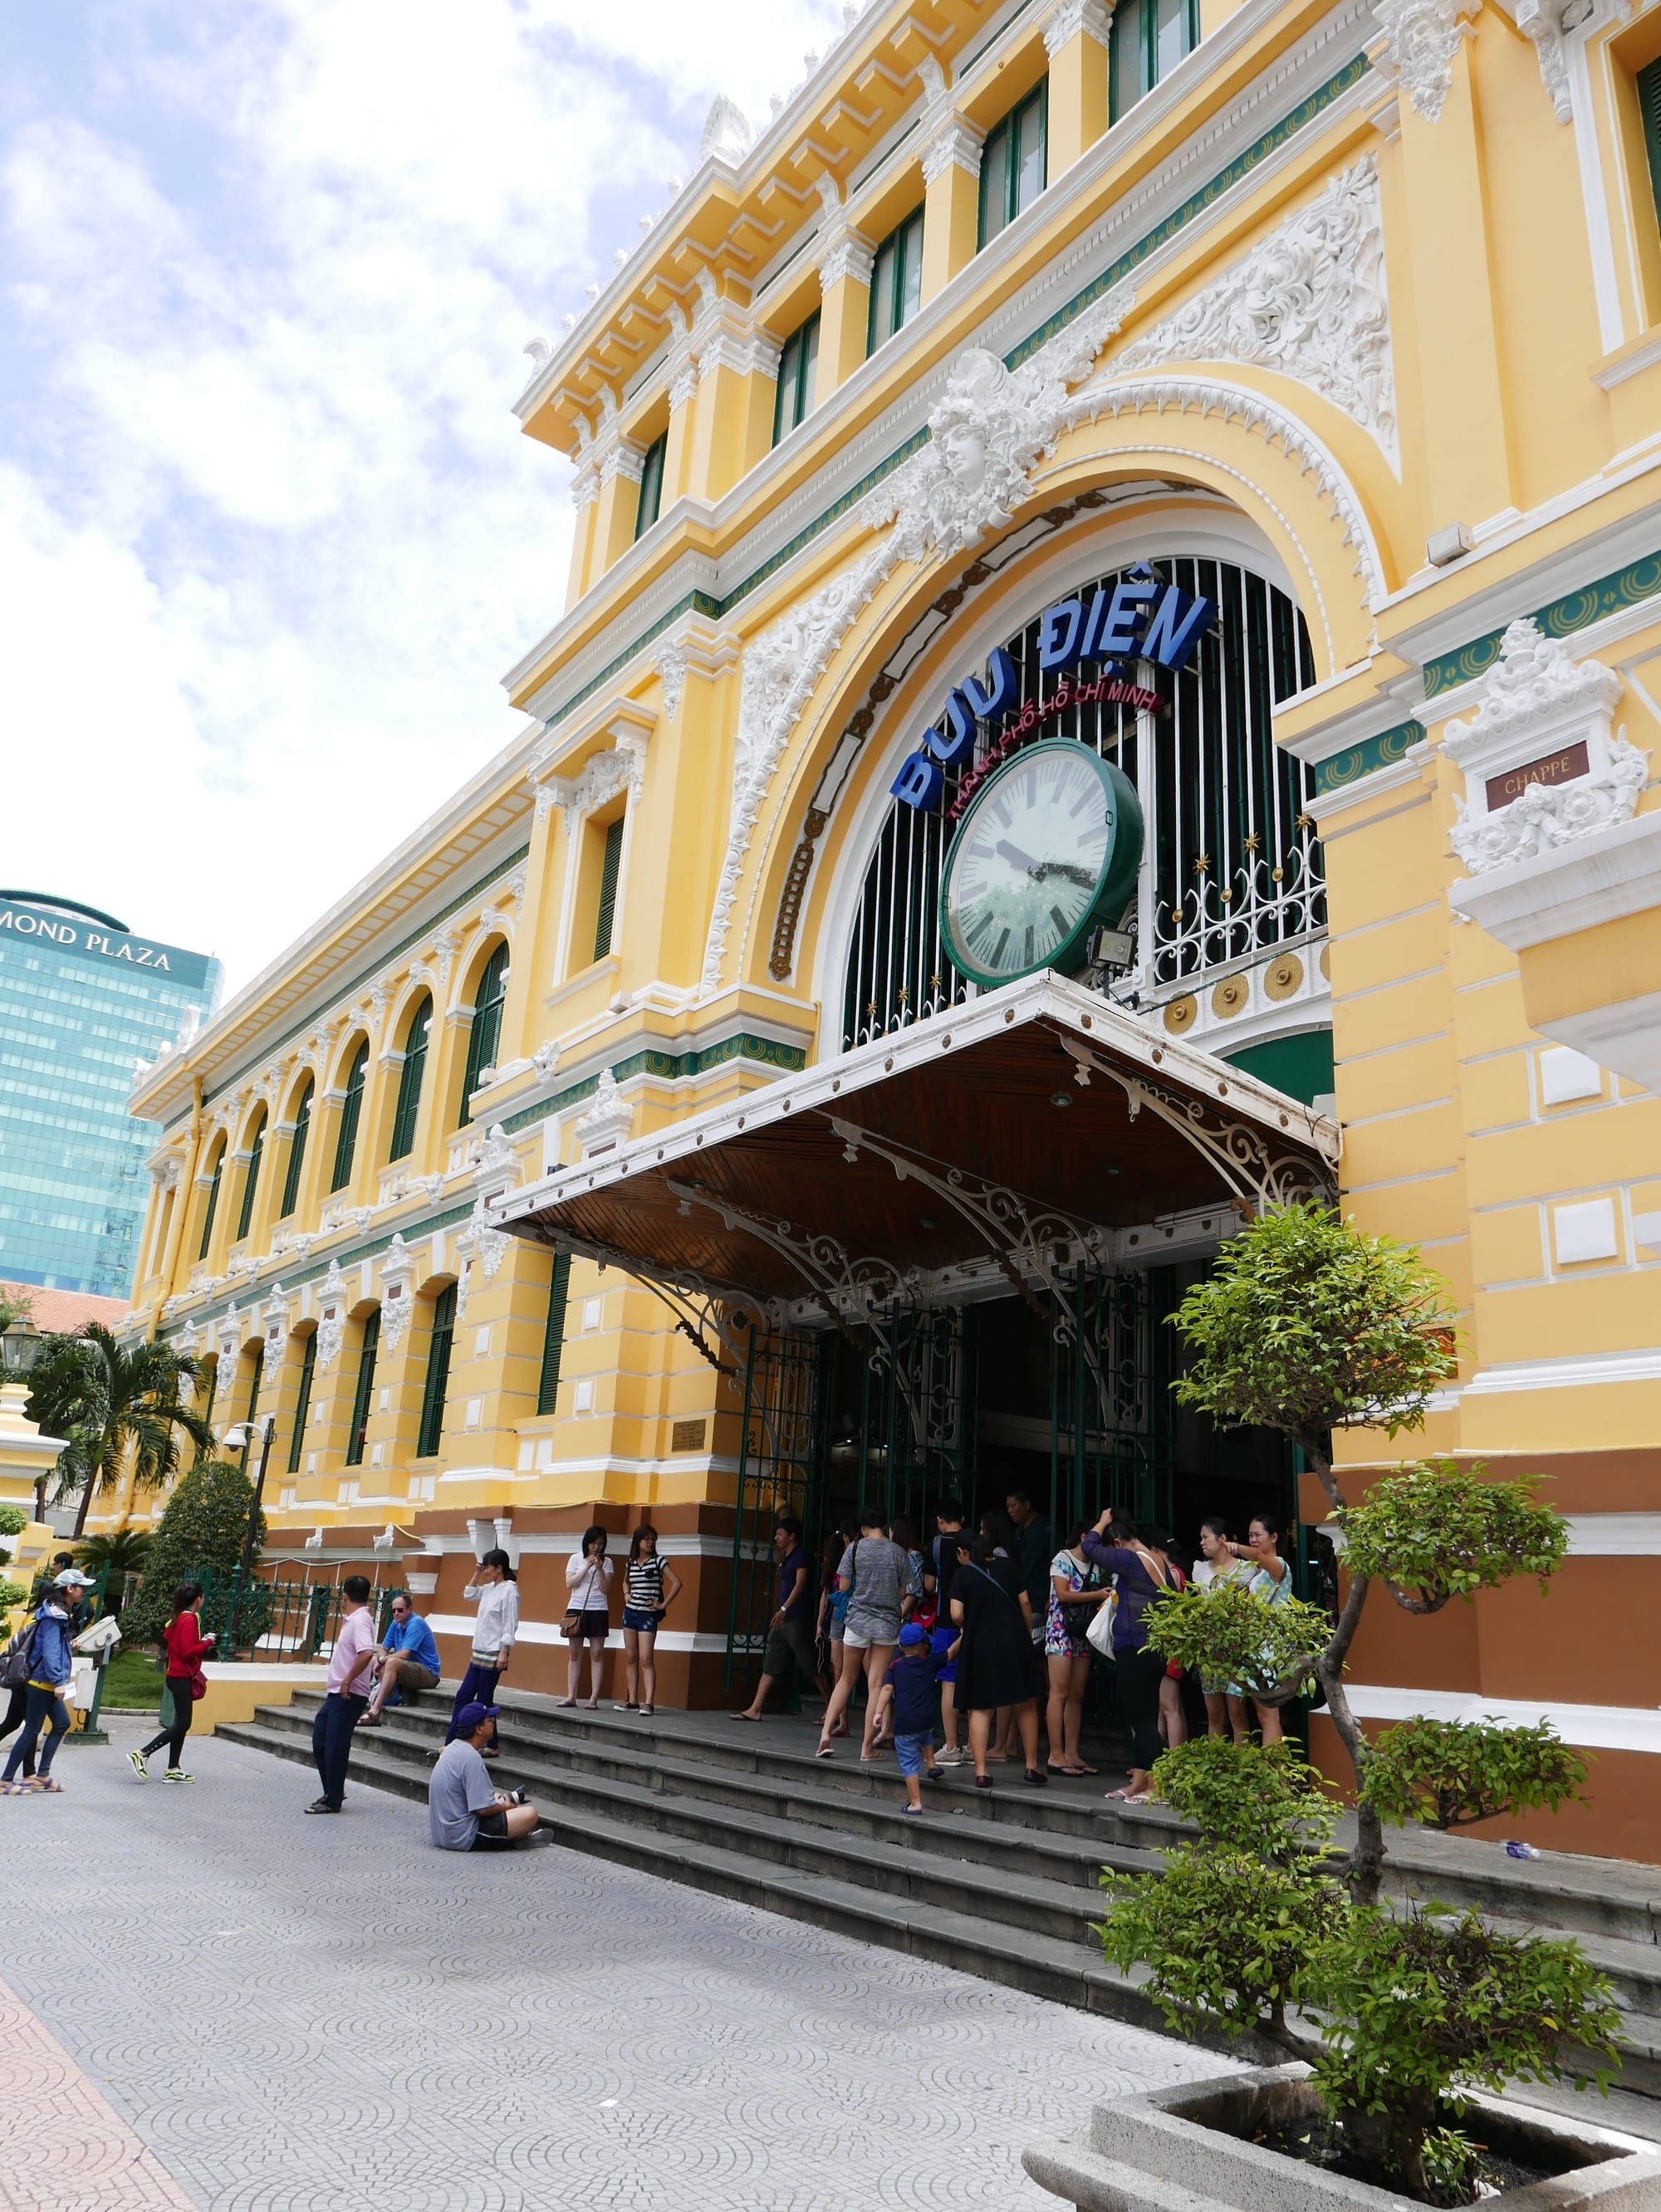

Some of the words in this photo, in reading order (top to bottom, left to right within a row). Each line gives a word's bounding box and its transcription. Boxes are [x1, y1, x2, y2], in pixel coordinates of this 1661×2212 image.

[1036, 561, 1217, 676] ĐIỆN
[999, 698, 1041, 749] PHỐ
[1041, 681, 1072, 716] HỒ
[1107, 683, 1162, 714] MINH
[1505, 758, 1570, 794] CHAPPE
[85, 933, 172, 972] PLAZA
